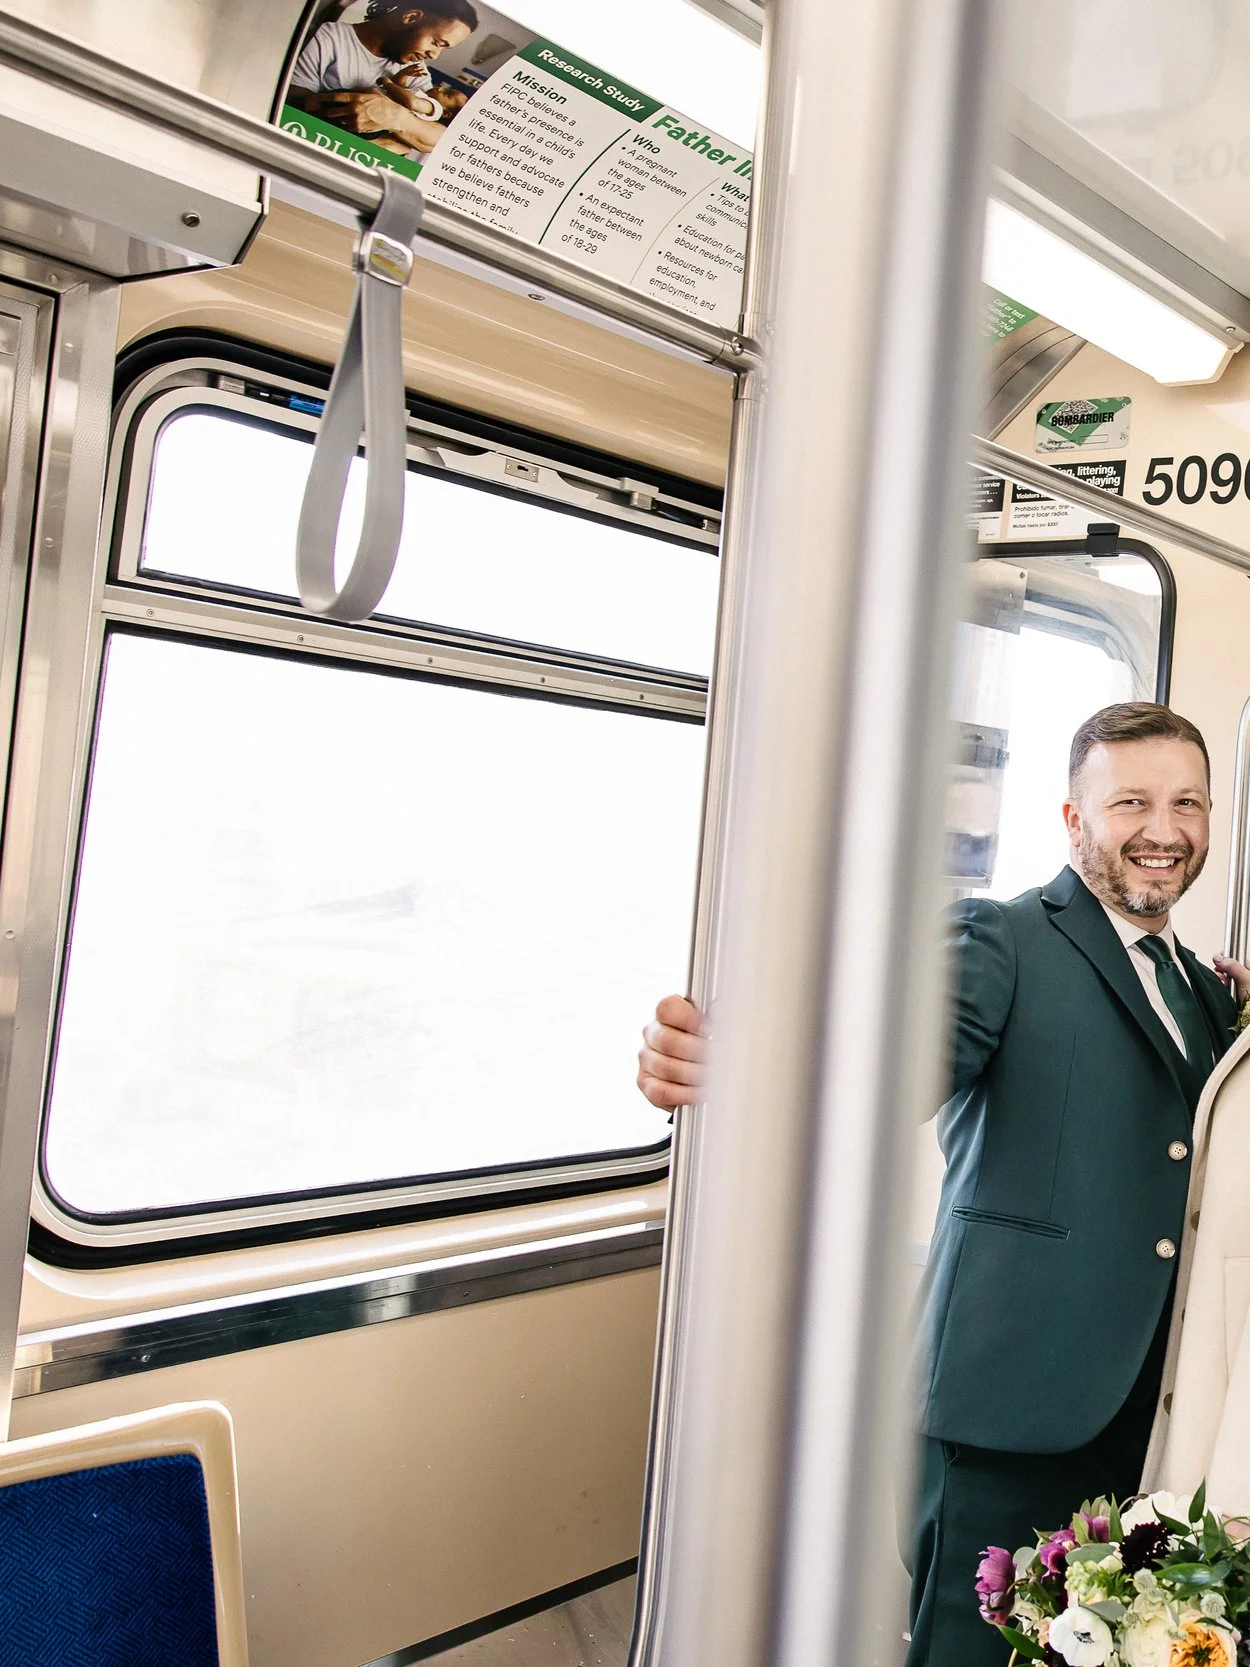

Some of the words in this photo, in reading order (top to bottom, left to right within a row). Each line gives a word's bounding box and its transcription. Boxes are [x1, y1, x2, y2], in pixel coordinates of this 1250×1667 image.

[513, 70, 568, 105] Mission
[538, 49, 603, 90] Research
[603, 85, 646, 112] Study
[500, 83, 528, 101] FIPC
[527, 97, 569, 122] believes
[569, 119, 577, 127] a
[479, 107, 526, 134] essential
[526, 130, 536, 140] in
[536, 136, 544, 144] a
[528, 115, 574, 142] presence
[574, 136, 585, 147] is
[651, 115, 737, 166] Father
[468, 119, 486, 134] life.
[489, 130, 516, 148] Every
[519, 145, 538, 161] day
[539, 154, 554, 165] we
[633, 134, 660, 154] Who
[450, 146, 466, 159] for
[466, 154, 502, 177] fathers
[504, 172, 545, 196] because
[458, 134, 500, 158] support
[500, 152, 520, 167] and
[520, 163, 565, 188] advocate
[627, 149, 636, 158] A
[635, 154, 678, 178] pregnant
[441, 162, 456, 174] we
[458, 168, 494, 191] believe
[495, 185, 531, 208] fathers
[597, 178, 608, 189] of
[608, 184, 634, 200] 17-25
[607, 168, 623, 180] the
[624, 178, 646, 192] ages
[617, 159, 649, 178] woman
[650, 174, 687, 197] between
[721, 182, 750, 202] What
[432, 177, 489, 207] strengthen
[490, 202, 510, 216] and
[585, 194, 599, 206] An
[600, 201, 644, 227] expectant
[717, 195, 735, 208] Tips
[569, 218, 586, 232] the
[586, 228, 608, 242] ages
[577, 206, 605, 223] father
[605, 218, 643, 242] between
[696, 213, 718, 227] skills
[561, 234, 573, 243] of
[573, 238, 598, 255] 18-29
[674, 236, 699, 253] about
[698, 248, 733, 268] newborn
[683, 226, 723, 249] Education
[724, 244, 736, 255] for
[656, 265, 696, 288] education,
[664, 251, 705, 276] Resources
[705, 270, 718, 281] for
[649, 277, 698, 305] employment,
[700, 300, 716, 311] and
[1051, 412, 1114, 427] BOMBARDIER
[1077, 465, 1116, 476] littering,
[1086, 476, 1120, 487] playing
